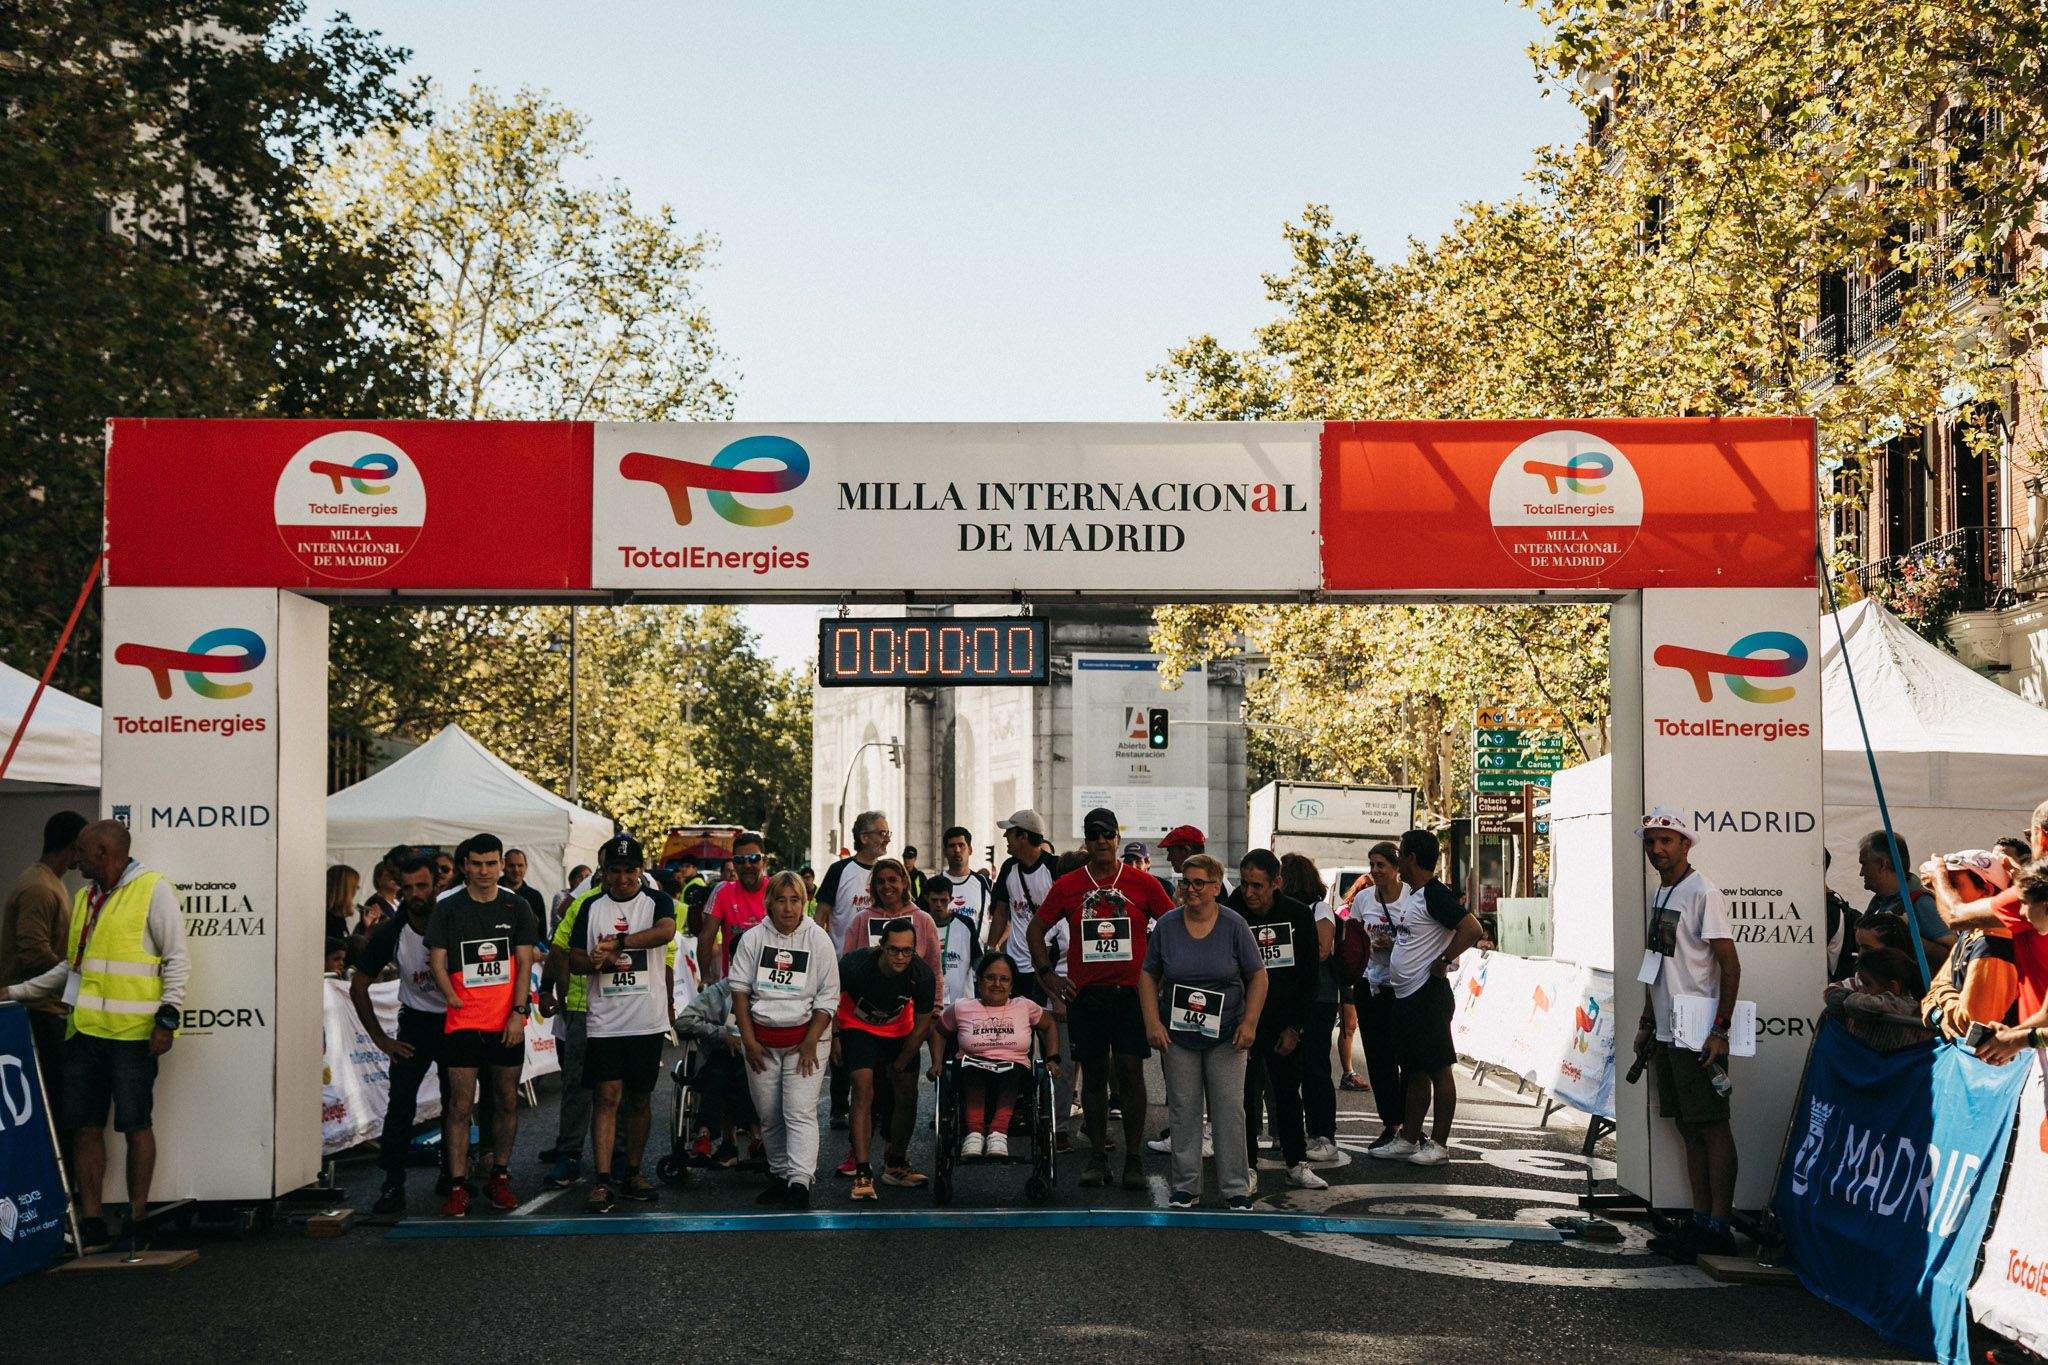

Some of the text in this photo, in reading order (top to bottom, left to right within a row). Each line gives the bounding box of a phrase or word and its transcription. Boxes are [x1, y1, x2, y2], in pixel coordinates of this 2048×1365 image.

[836, 482, 967, 511] MILLA
[308, 503, 398, 517] TotalEnergies
[1523, 503, 1615, 517] TotalEnergies
[330, 529, 372, 541] MILLA
[957, 523, 1186, 553] DE MADRID
[1546, 530, 1589, 541] MILLA
[314, 556, 388, 566] DE MADRID
[618, 545, 810, 575] TotalEnergies
[1530, 556, 1605, 567] DE MADRID
[835, 627, 1033, 675] 00:00:00
[113, 714, 267, 737] TotalEnergies
[1654, 718, 1810, 742] TotalEnergies
[1118, 742, 1147, 750] Abierto
[1115, 751, 1165, 759] Restauración
[1527, 761, 1552, 769] Carlos
[1478, 797, 1507, 805] Palacio
[151, 805, 270, 828] MADRID
[1694, 811, 1816, 834] MADRID
[1480, 825, 1511, 833] América
[195, 881, 237, 891] balance
[1740, 887, 1783, 897] balance
[186, 917, 267, 937] RBANA
[1095, 939, 1119, 953] 429
[476, 961, 502, 977] 448
[612, 972, 636, 986] 445
[768, 969, 794, 985] 452
[1183, 1011, 1208, 1027] 442
[1829, 1123, 1981, 1238] MADRID
